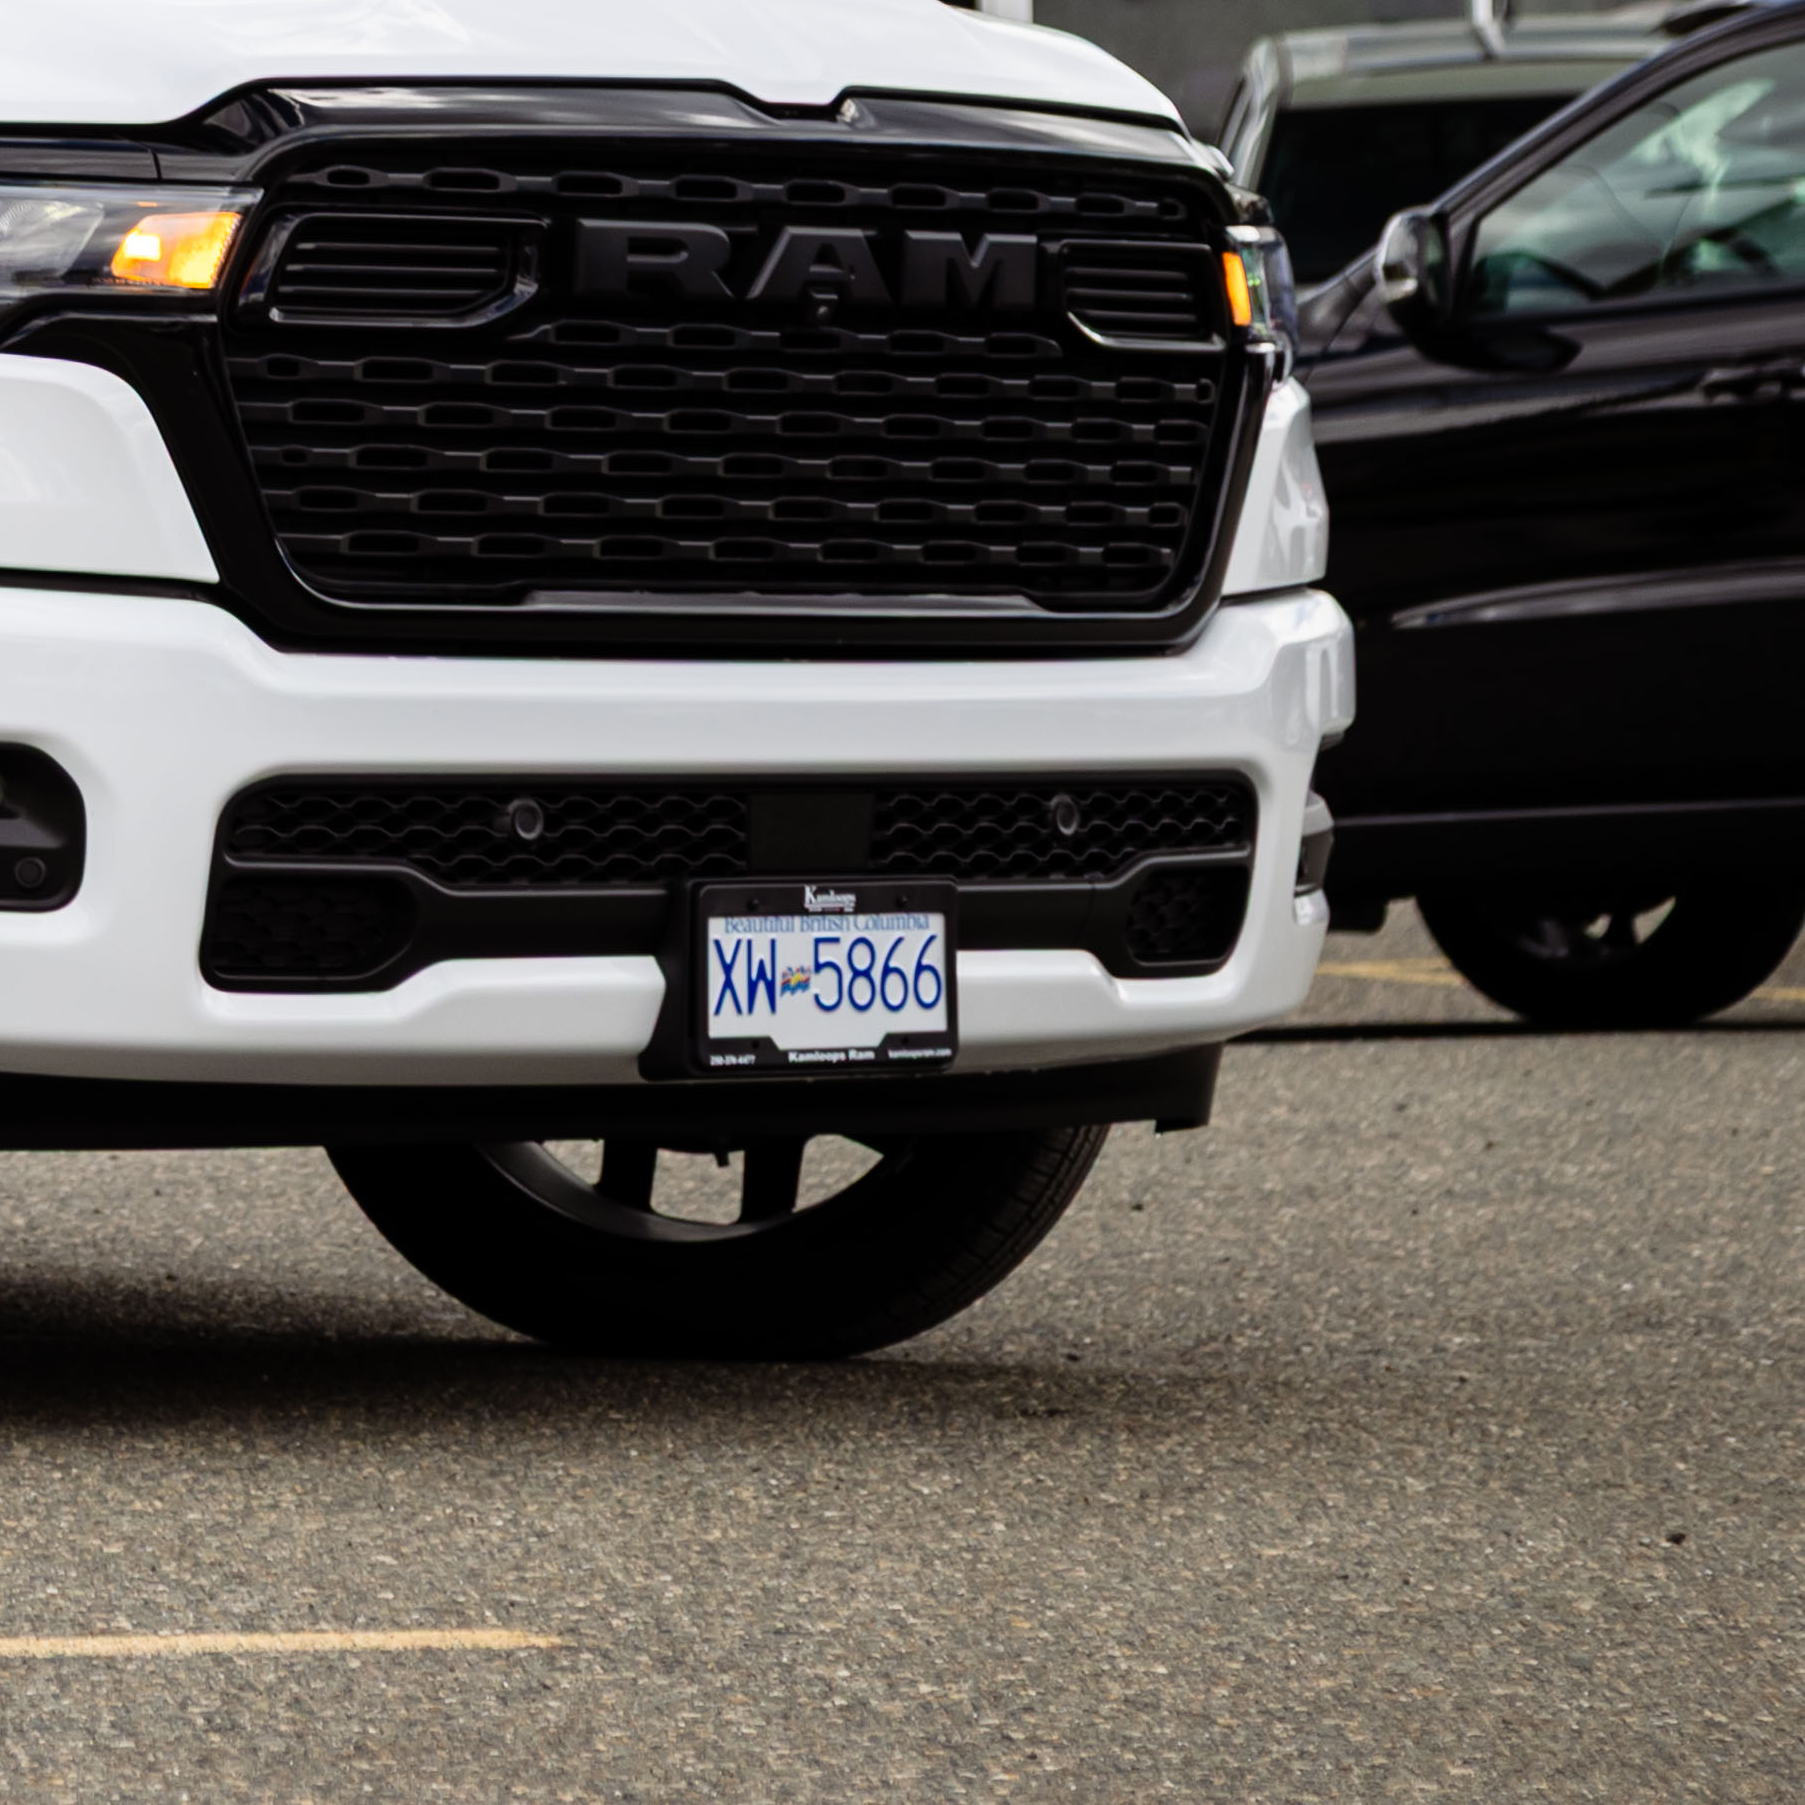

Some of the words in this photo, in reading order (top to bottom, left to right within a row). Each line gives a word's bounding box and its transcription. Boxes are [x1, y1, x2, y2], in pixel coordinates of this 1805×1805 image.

[577, 218, 1038, 307] RAM
[725, 916, 795, 934] Beautiful
[800, 915, 850, 933] British
[853, 914, 930, 932] Columbia
[713, 938, 777, 1016] XW
[813, 934, 942, 1013] 5866
[788, 1050, 846, 1064] Kamloops
[848, 1049, 876, 1062] Ram
